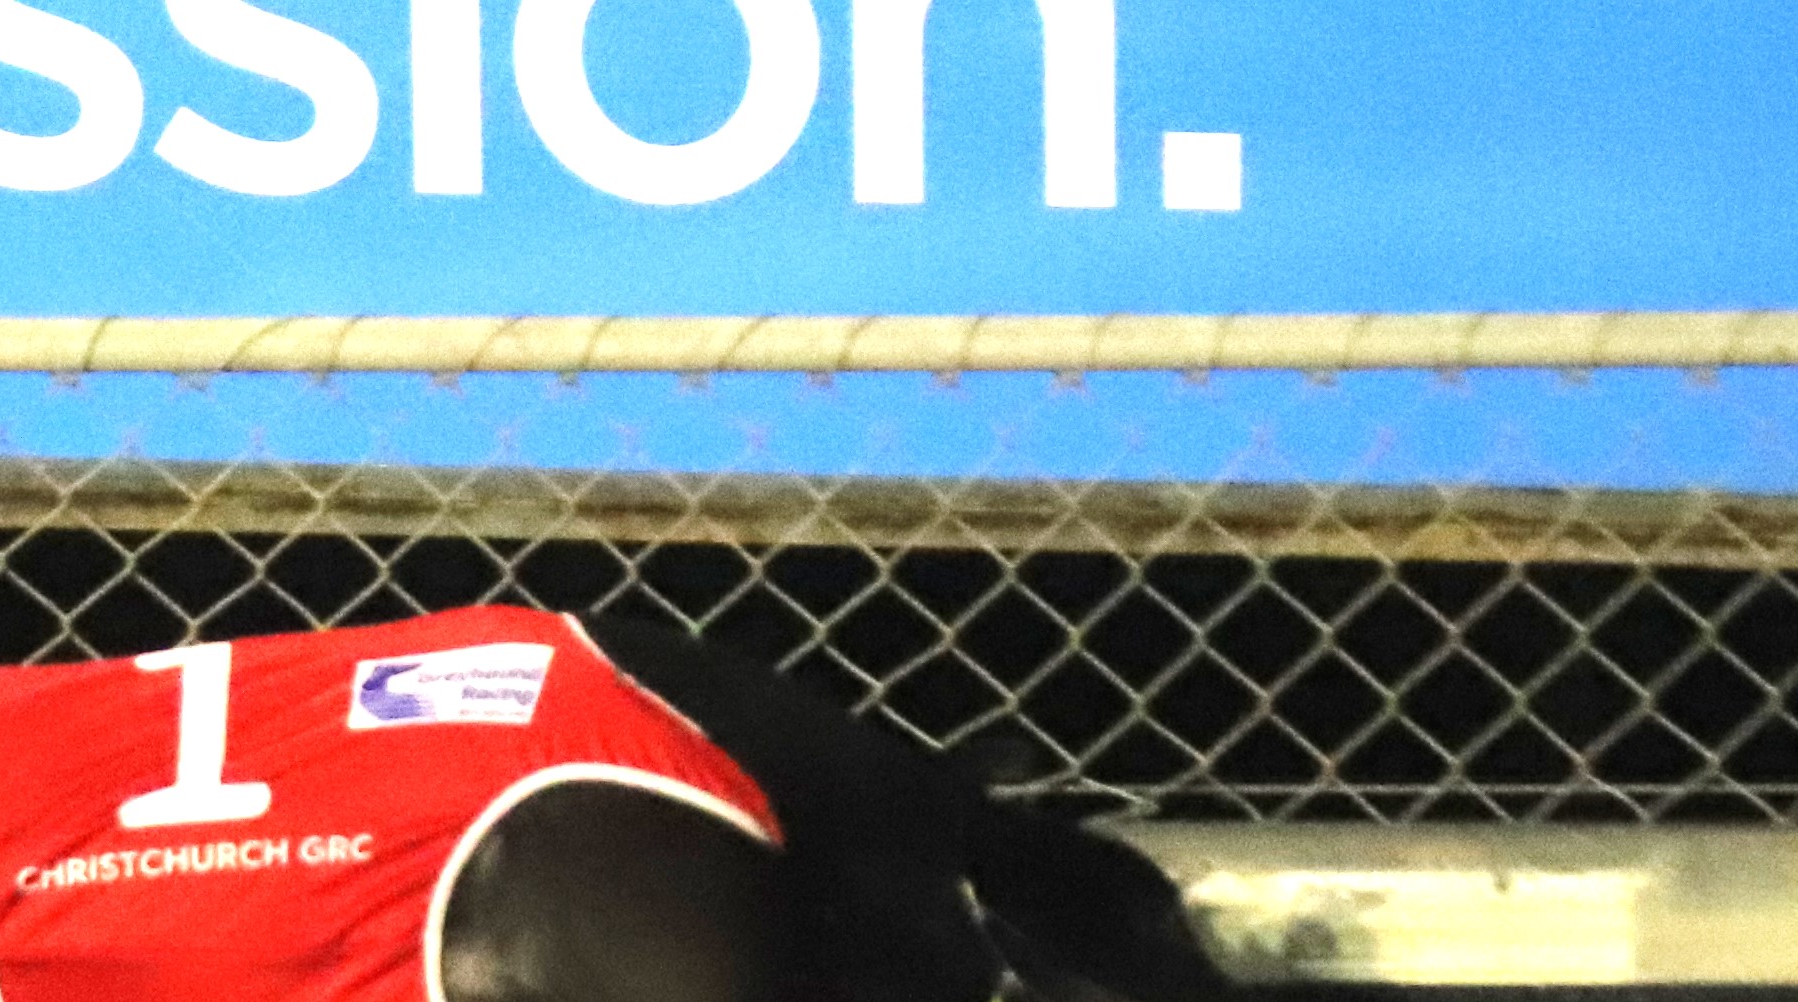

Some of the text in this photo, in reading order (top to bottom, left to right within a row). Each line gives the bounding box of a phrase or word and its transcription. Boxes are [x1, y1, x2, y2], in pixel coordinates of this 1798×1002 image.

[117, 640, 271, 828] 1
[16, 834, 374, 892] CHRISTCHURCH GRC
